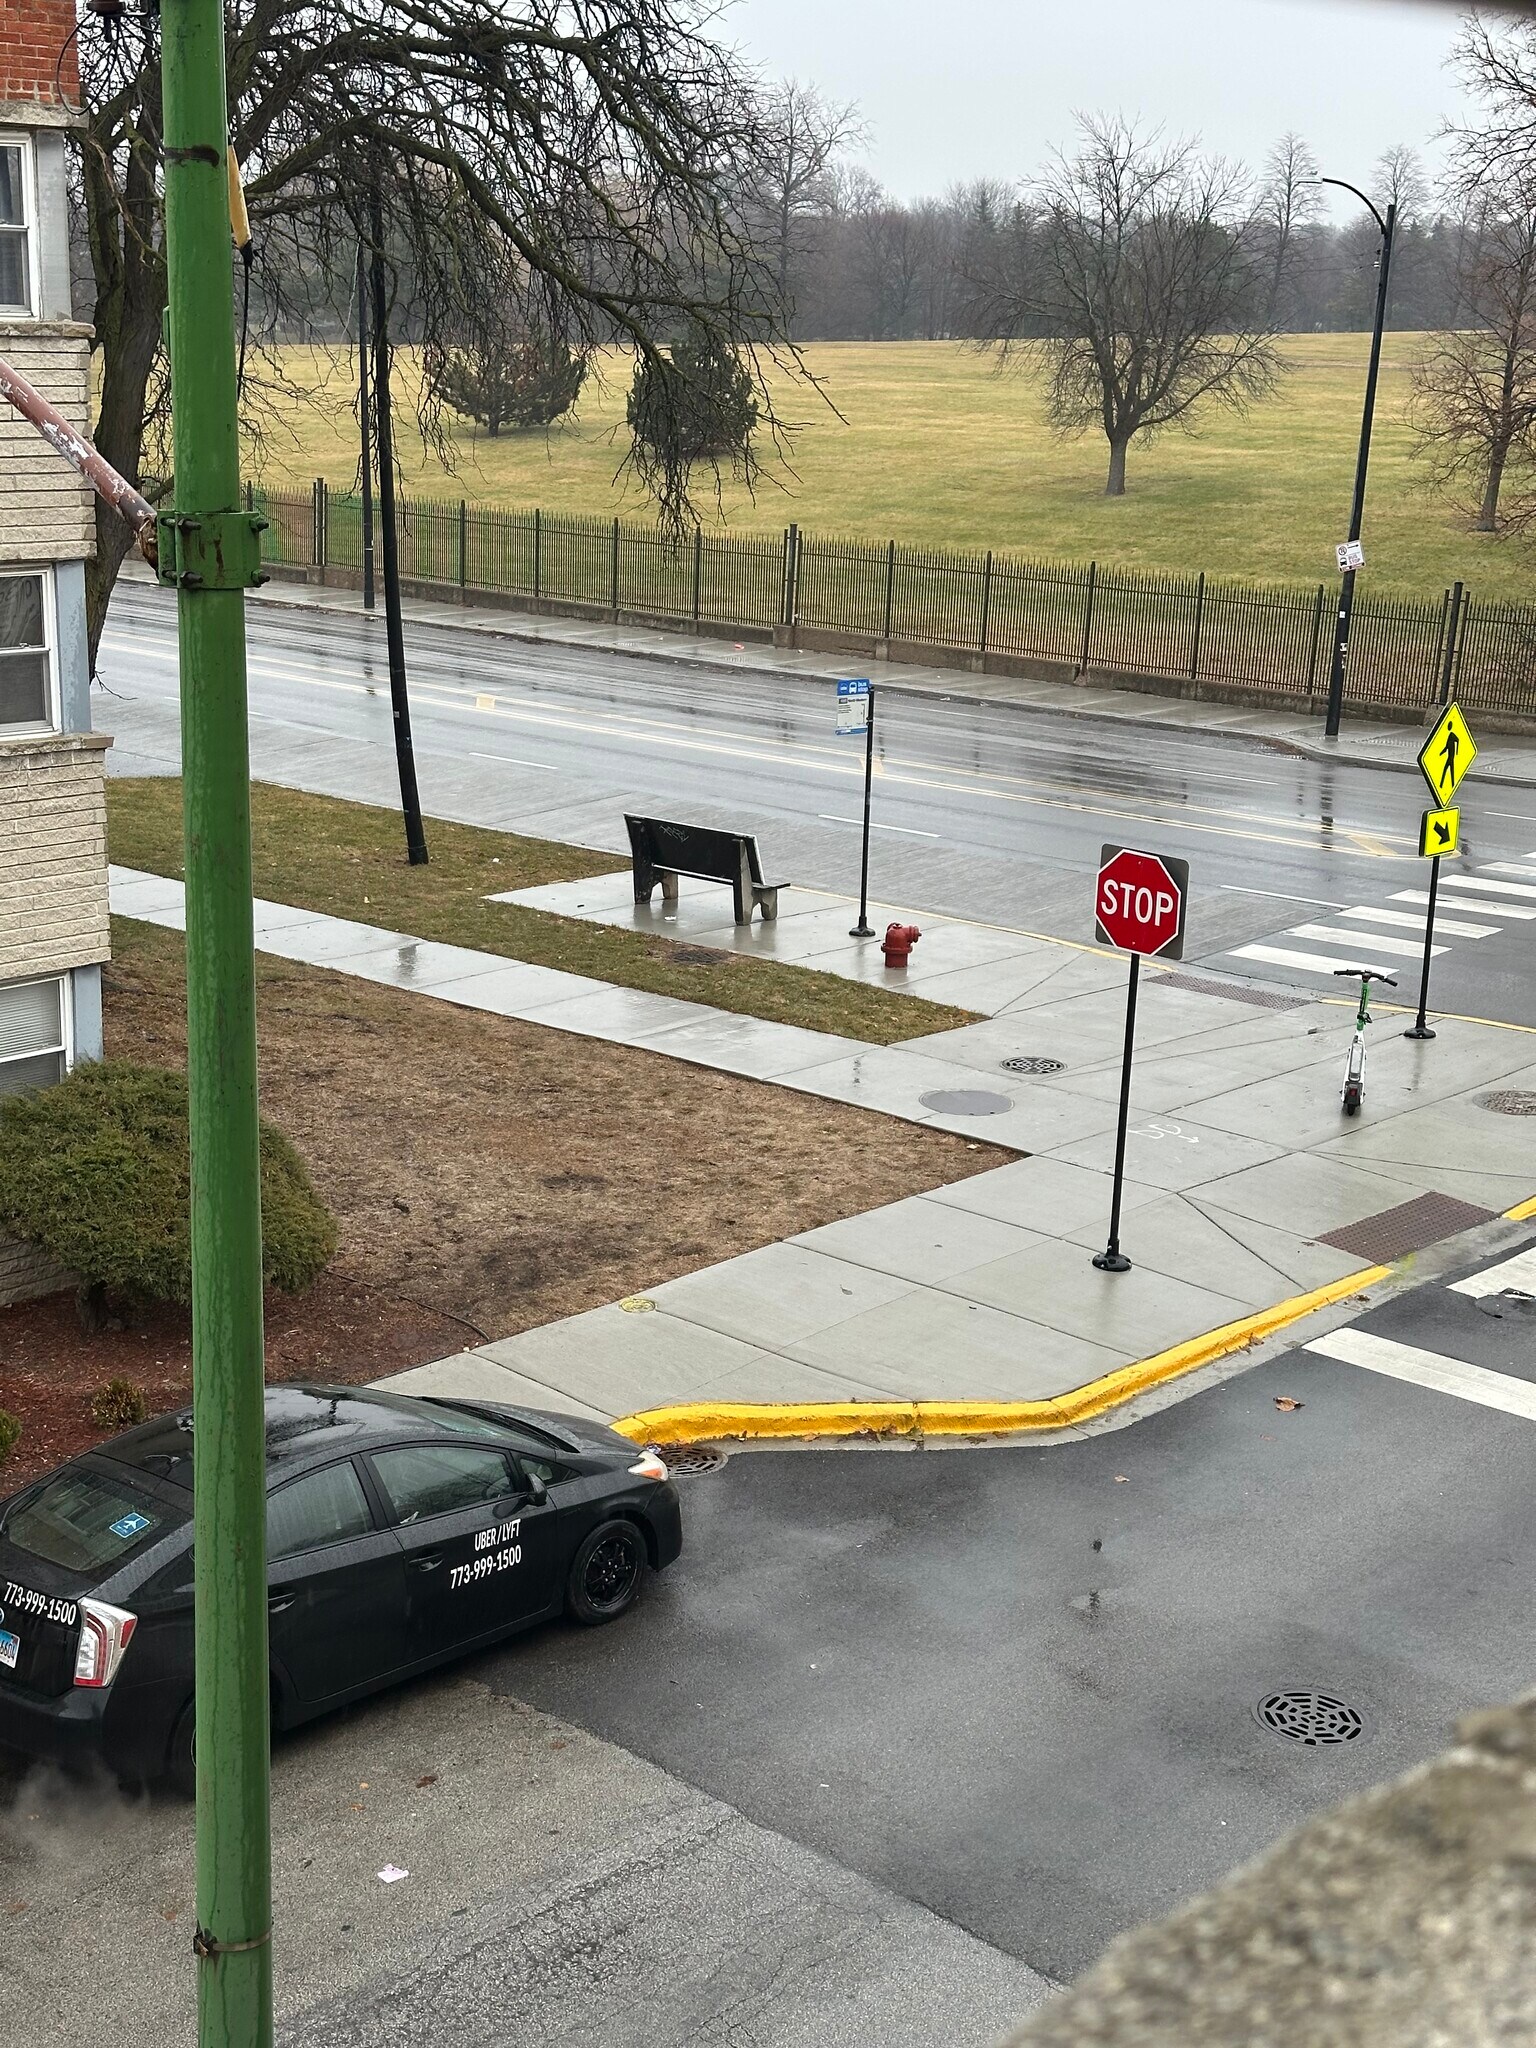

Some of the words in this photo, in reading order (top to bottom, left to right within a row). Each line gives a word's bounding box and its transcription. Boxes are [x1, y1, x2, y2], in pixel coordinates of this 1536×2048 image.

[1101, 879, 1174, 926] STOP
[474, 1518, 521, 1551] UBER/LYFT
[450, 1544, 522, 1589] 773-999-1500
[3, 1581, 77, 1626] 773-999-1500
